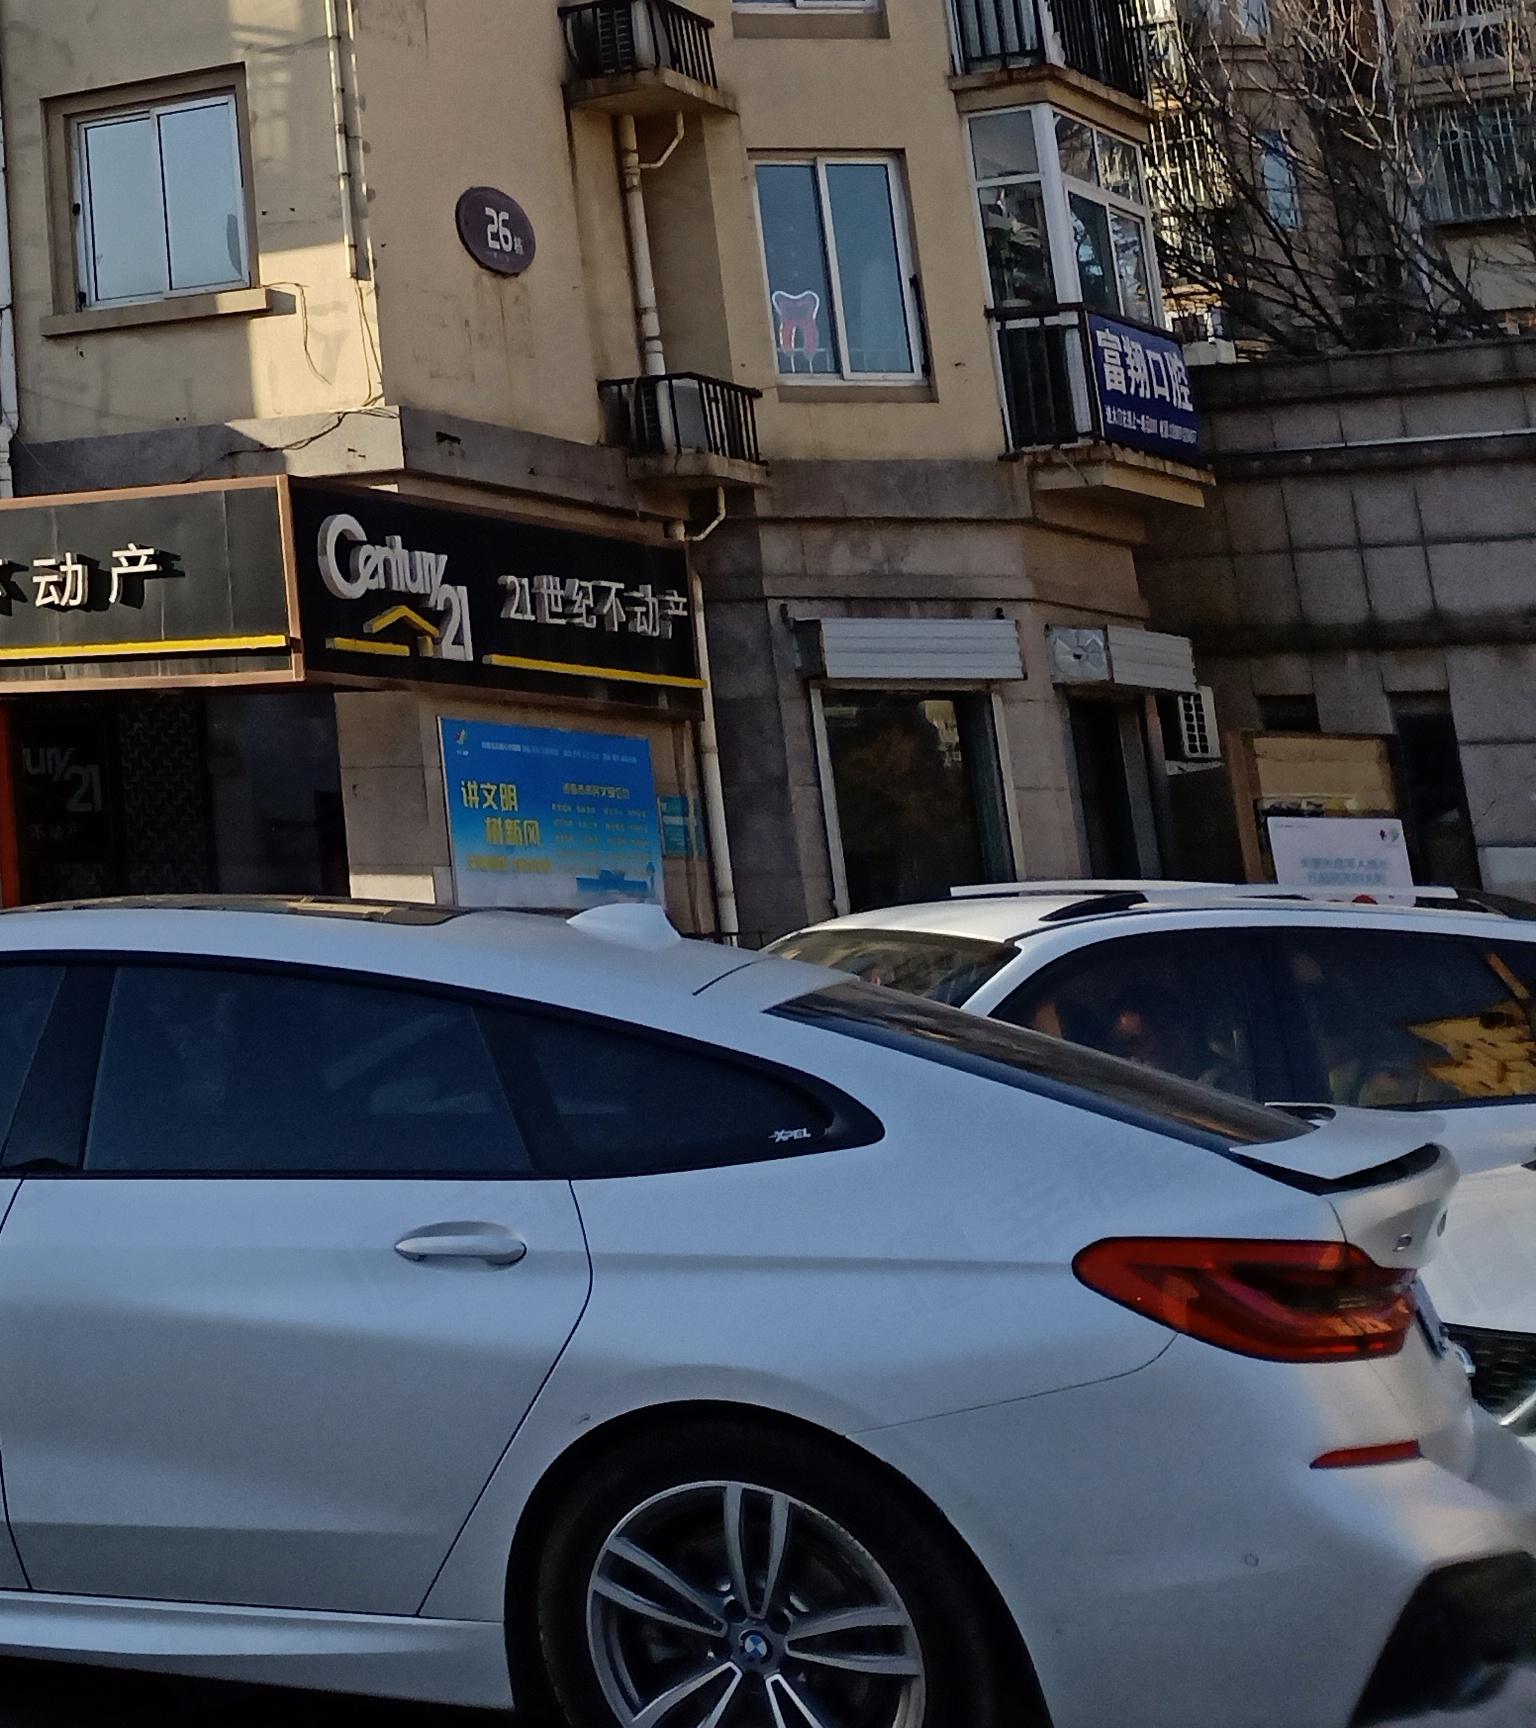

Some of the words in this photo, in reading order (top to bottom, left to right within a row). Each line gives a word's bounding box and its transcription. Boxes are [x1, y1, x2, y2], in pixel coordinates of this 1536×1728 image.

[1095, 328, 1194, 412] 富翔口腔
[317, 513, 448, 608] Century
[434, 584, 474, 661] 21
[497, 574, 688, 639] 21世纪不动产
[460, 779, 519, 813] 讲文明
[484, 816, 542, 847] 树新风
